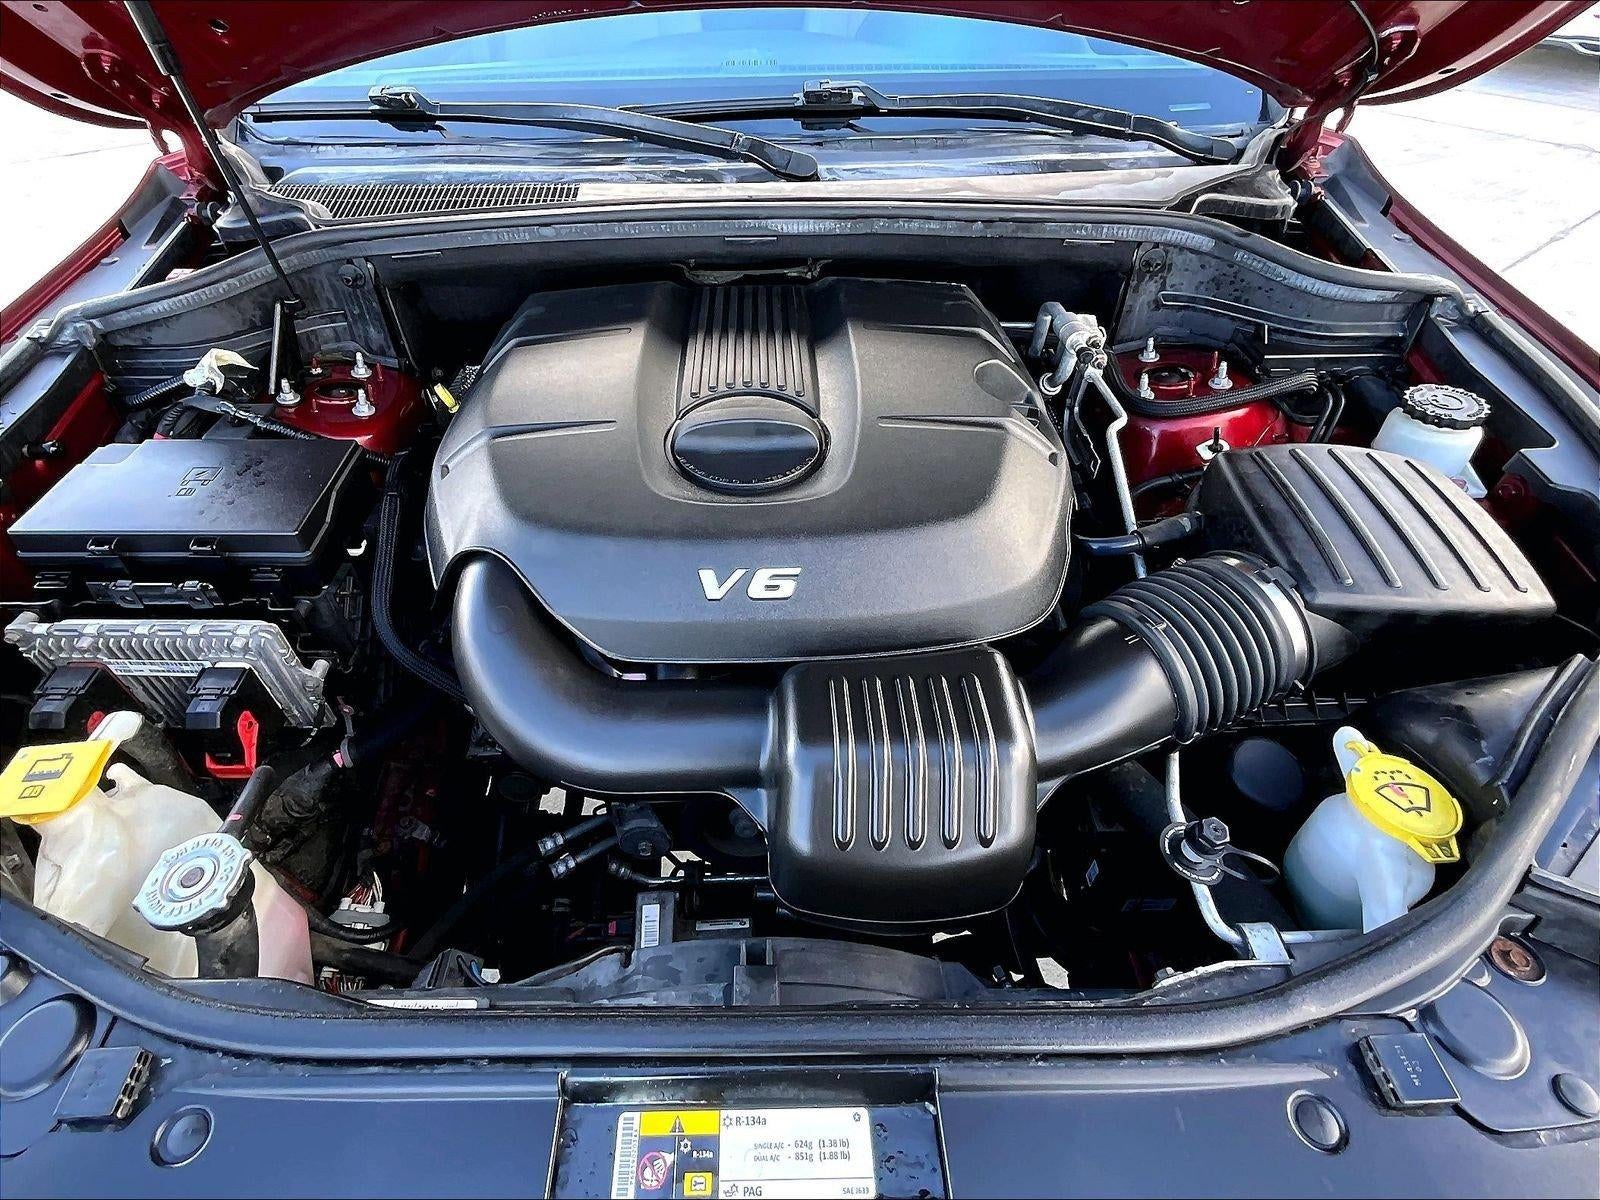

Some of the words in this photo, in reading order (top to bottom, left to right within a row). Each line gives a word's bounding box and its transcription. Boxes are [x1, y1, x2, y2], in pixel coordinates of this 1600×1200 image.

[697, 566, 802, 601] V6
[735, 1115, 767, 1127] R-134a
[773, 1141, 784, 1150] A/C
[794, 1139, 813, 1150] 624g
[769, 1154, 780, 1162] A/C
[794, 1152, 814, 1162] 851g
[743, 1186, 762, 1197] PAG
